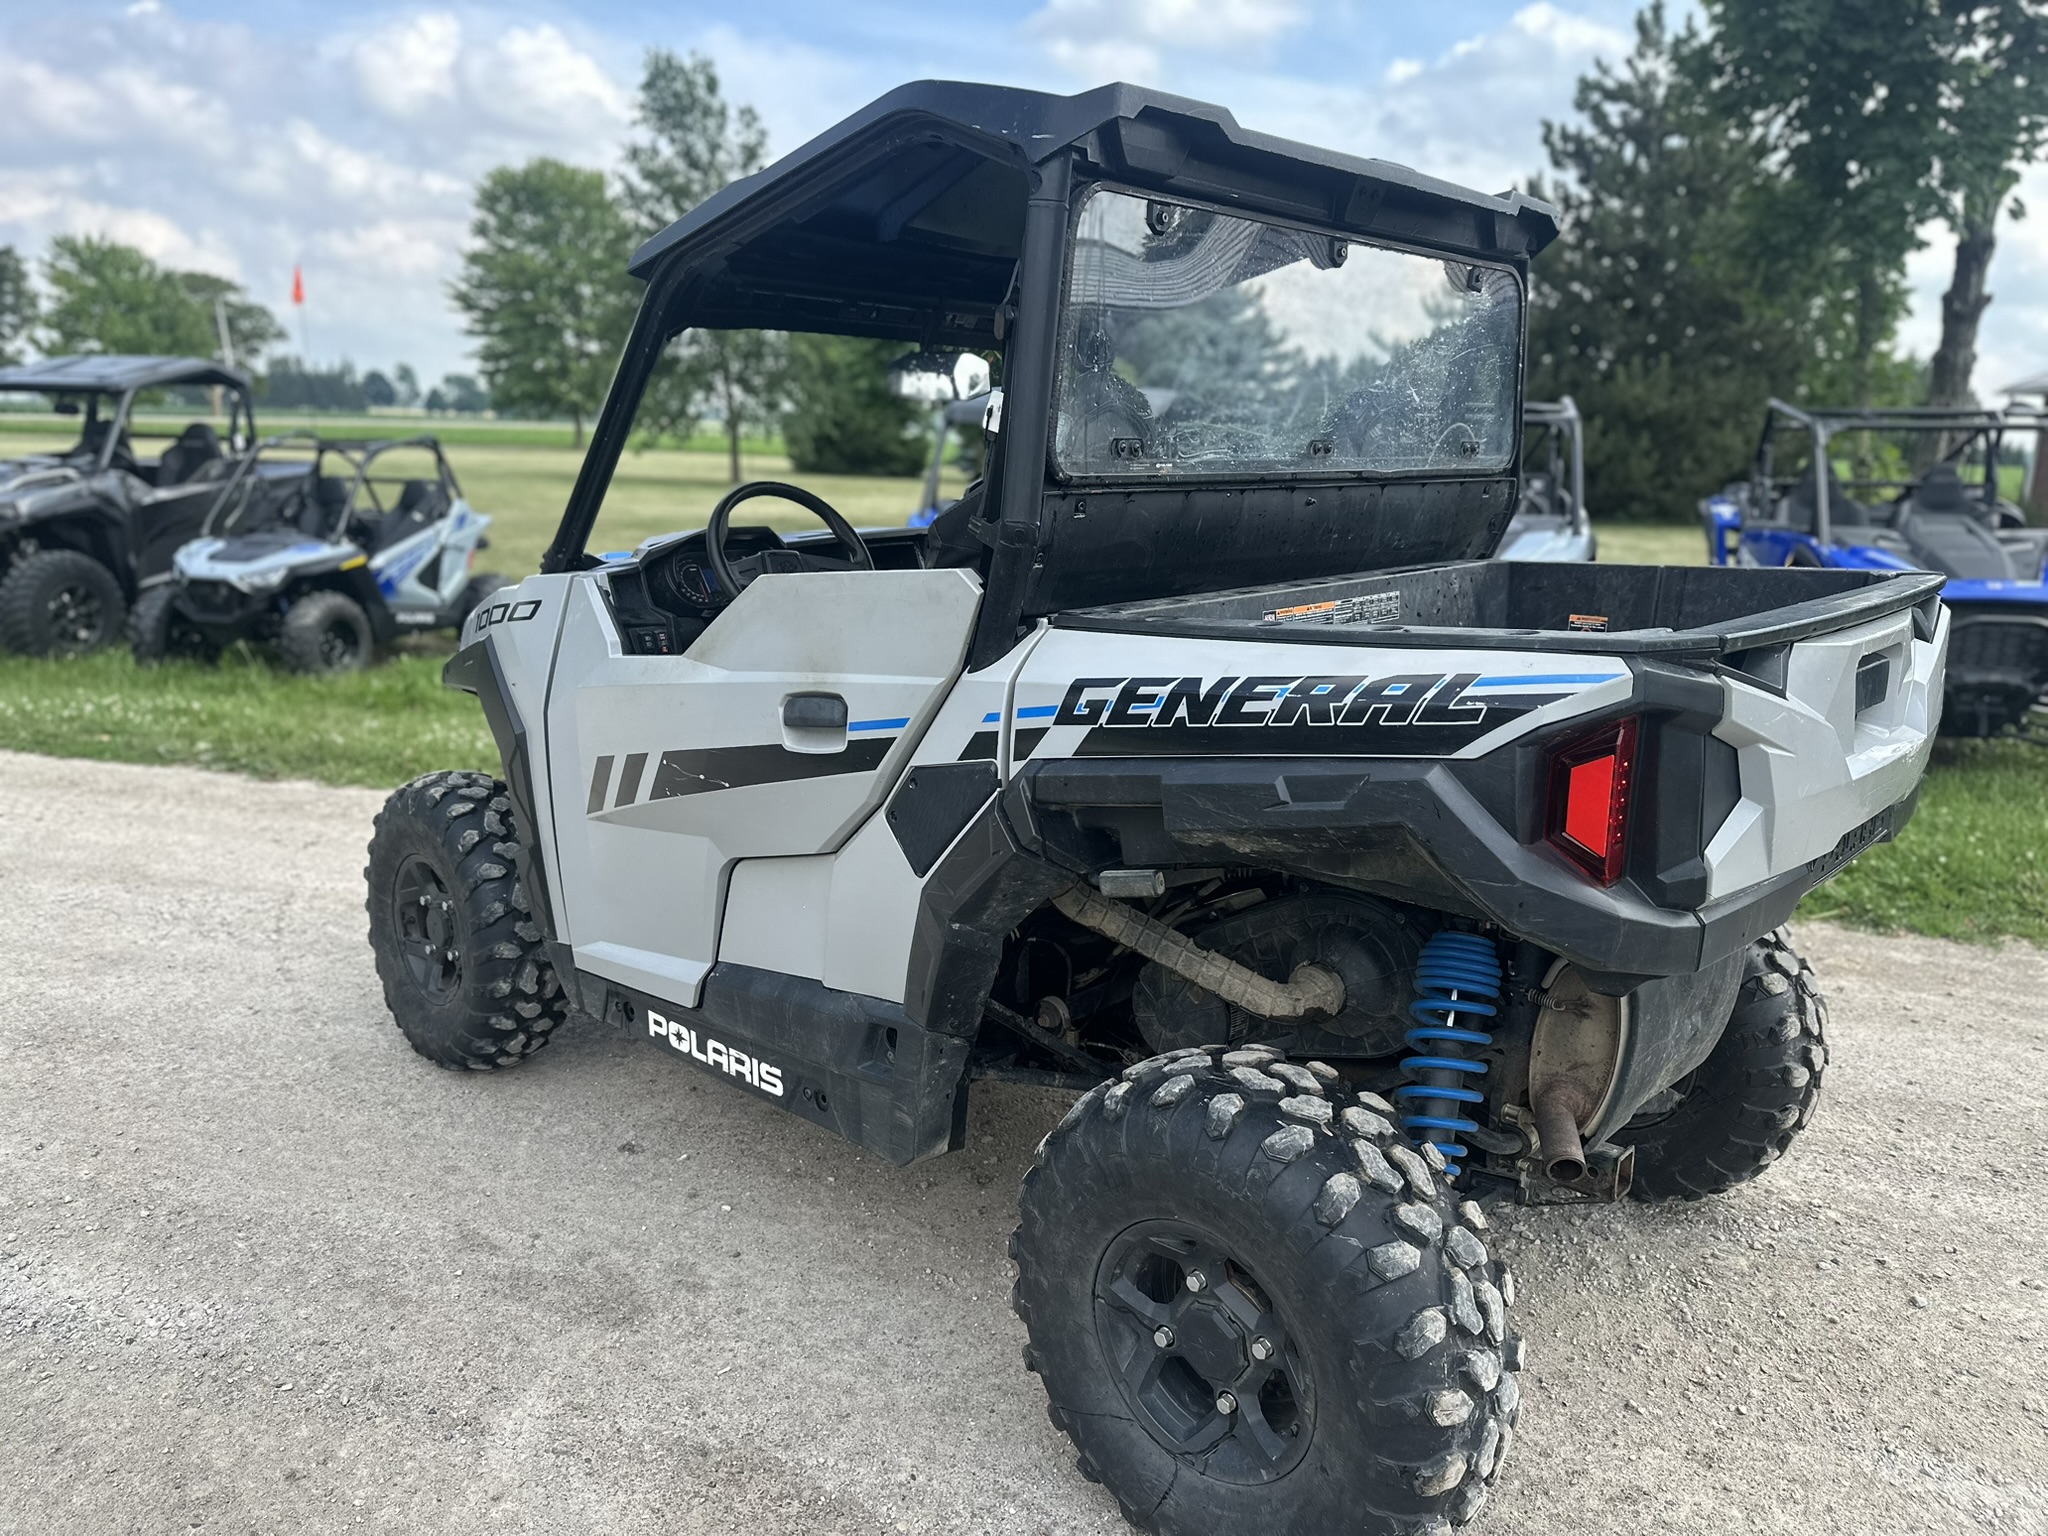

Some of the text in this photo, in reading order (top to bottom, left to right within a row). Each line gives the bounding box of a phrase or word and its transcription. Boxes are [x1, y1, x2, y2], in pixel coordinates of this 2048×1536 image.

[475, 599, 543, 633] 1000
[1052, 673, 1487, 727] GENERAL
[647, 1009, 784, 1097] POLARIS
